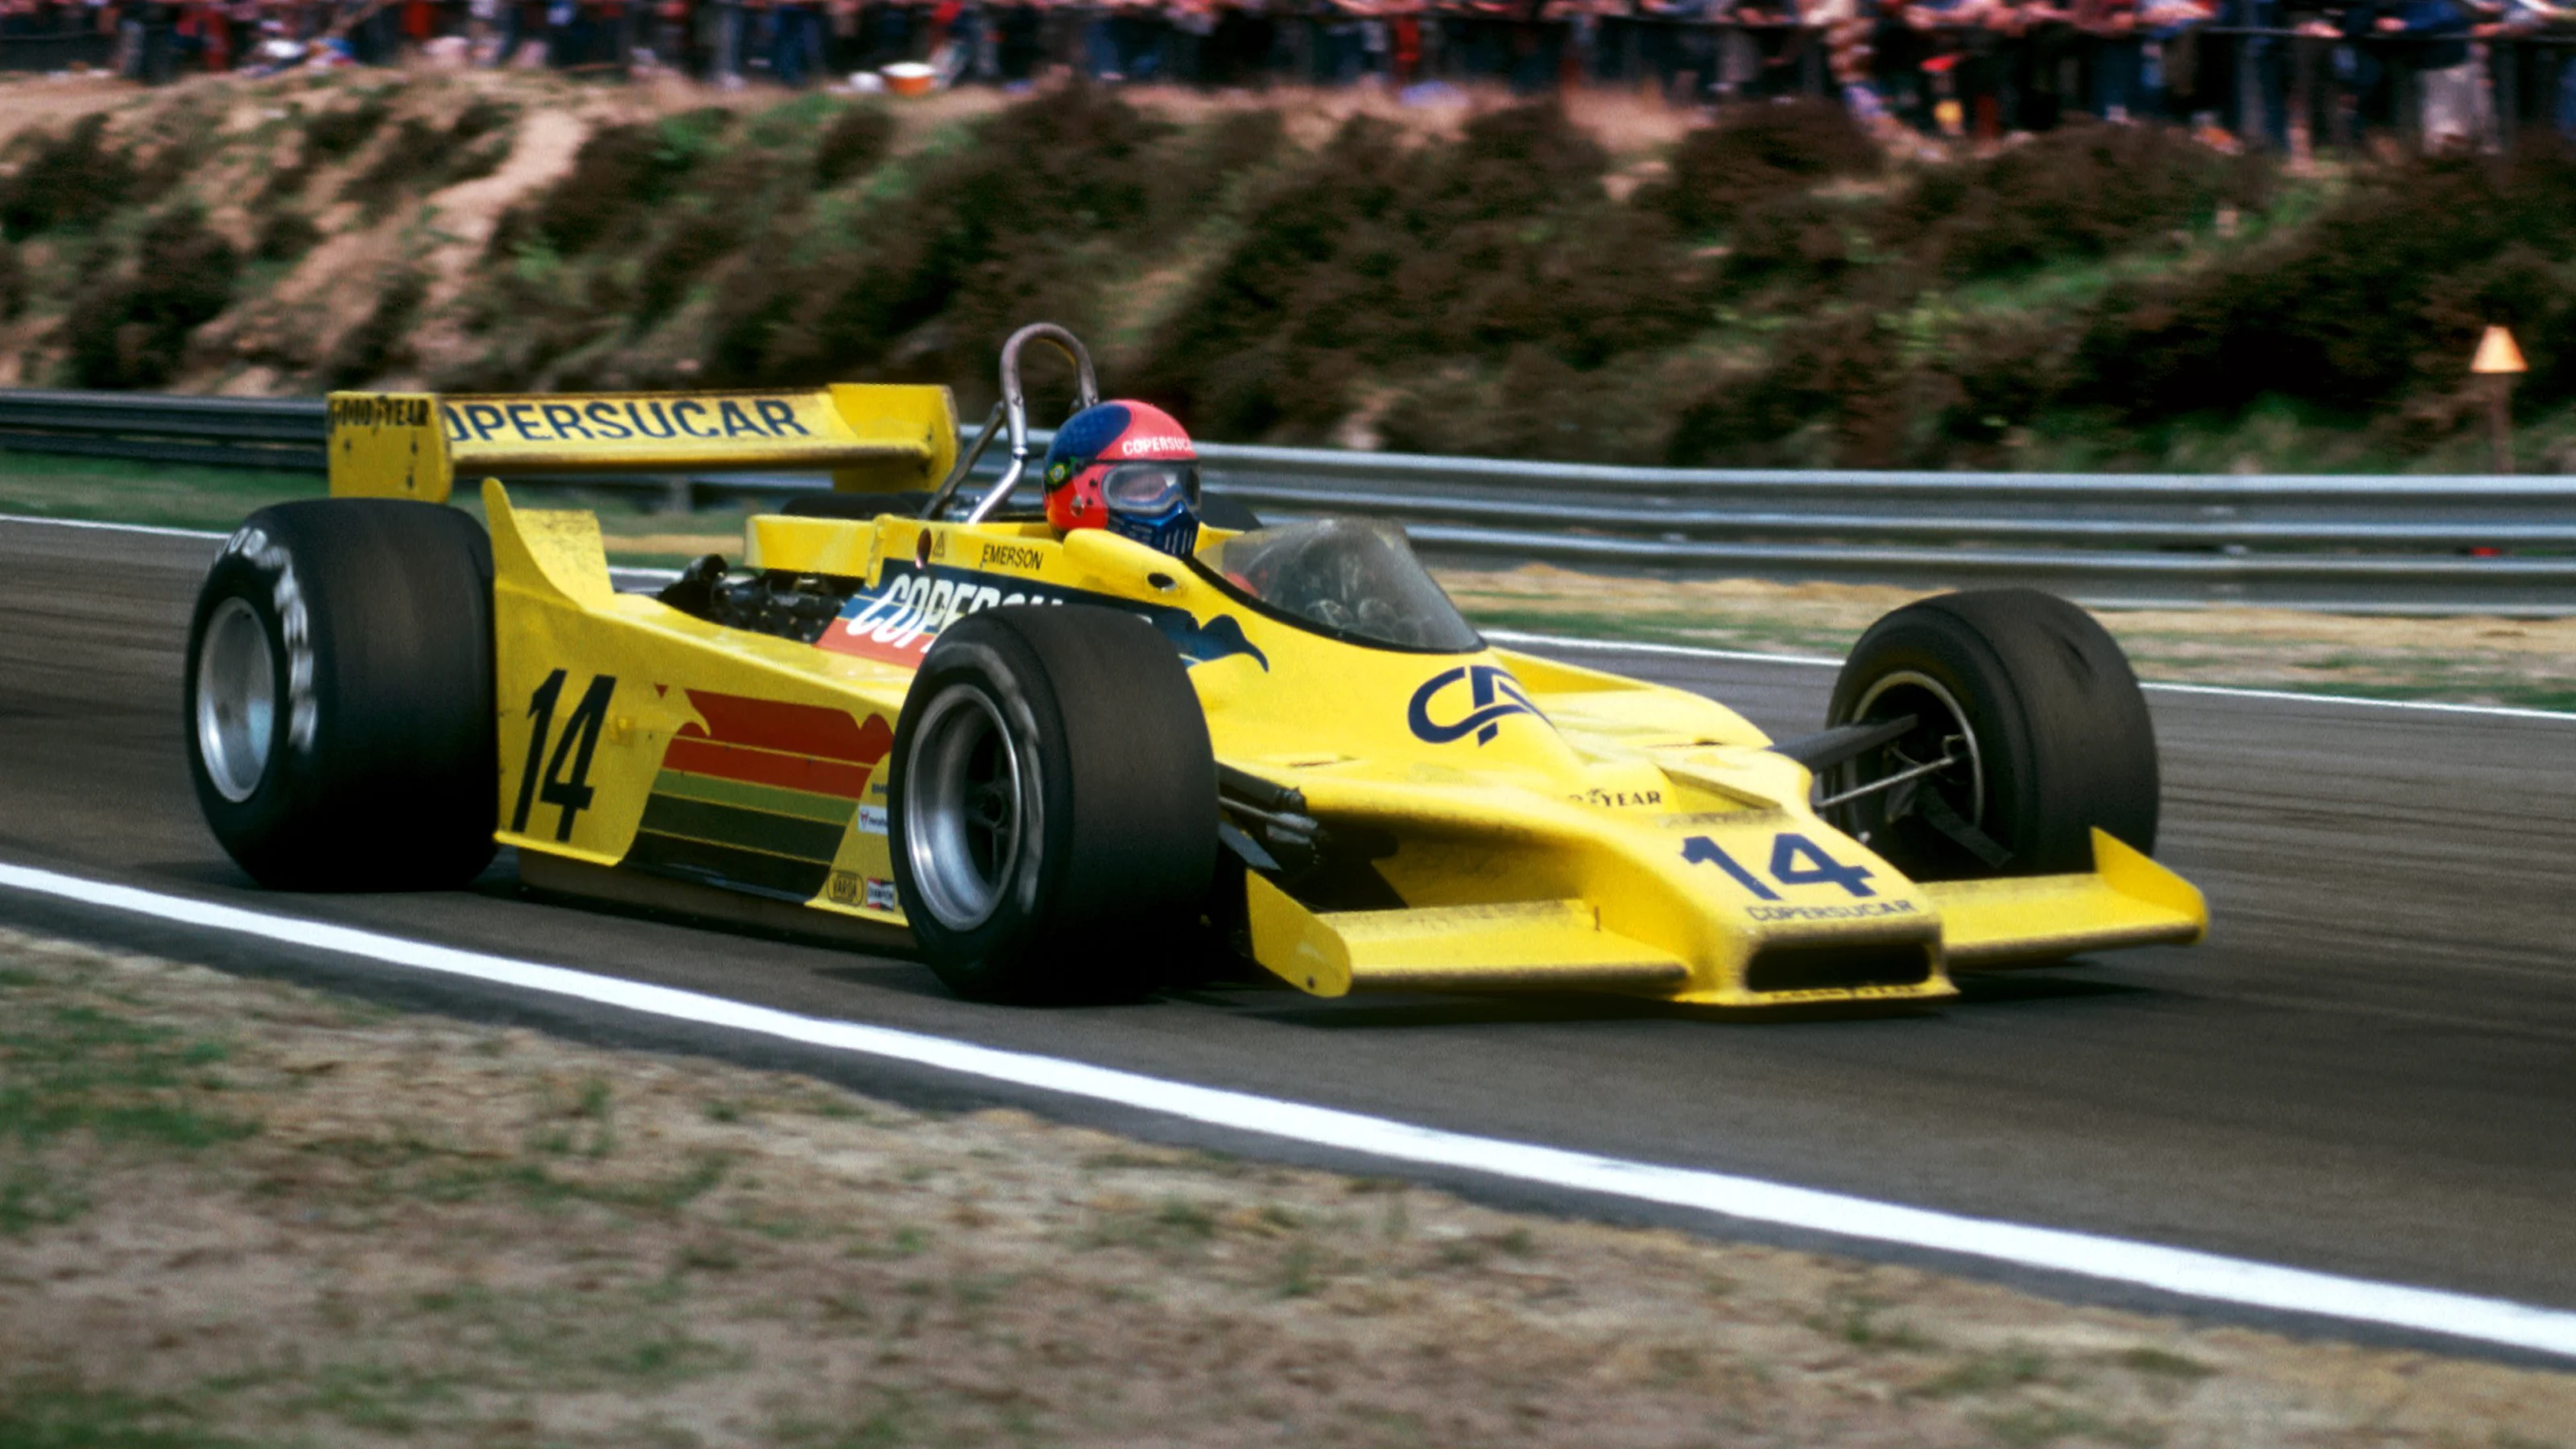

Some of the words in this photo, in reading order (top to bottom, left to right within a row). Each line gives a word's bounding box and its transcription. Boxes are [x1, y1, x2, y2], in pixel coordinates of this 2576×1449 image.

[444, 400, 809, 441] OPERSUCAR
[982, 544, 1044, 571] EMERSON
[511, 668, 617, 842] 14
[1680, 832, 1878, 901] 14
[1745, 899, 1919, 922] COPERSUCAR
